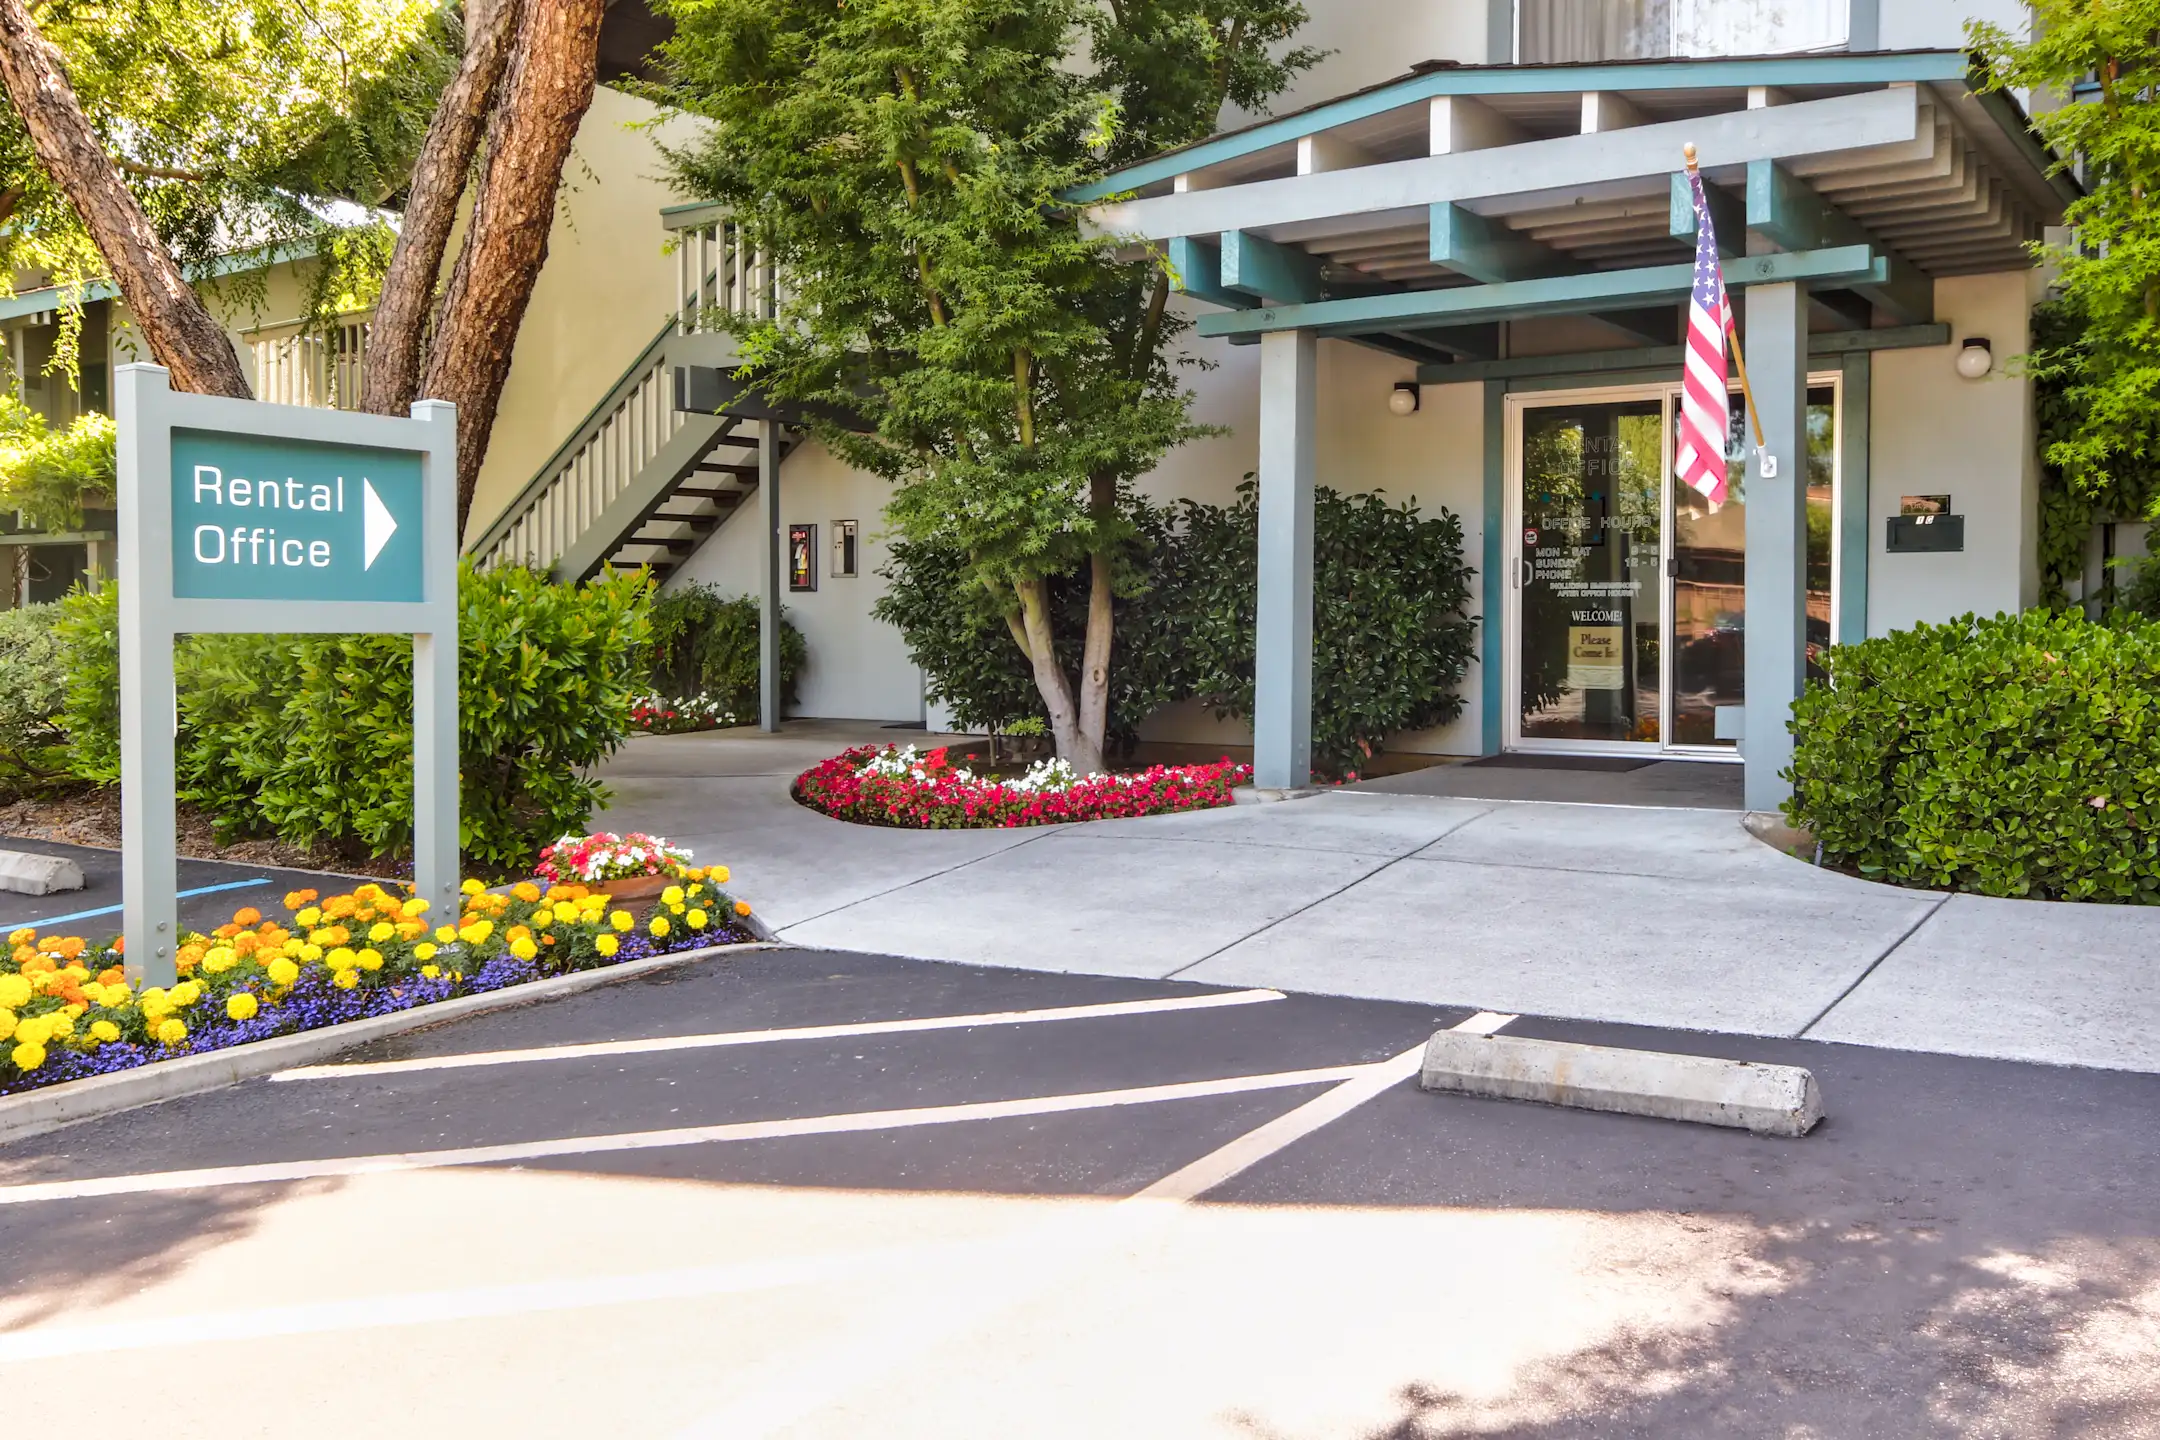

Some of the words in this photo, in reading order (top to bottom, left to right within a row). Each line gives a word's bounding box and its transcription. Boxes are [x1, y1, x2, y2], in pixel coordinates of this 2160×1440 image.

[1558, 458, 1635, 477] OFFICE
[193, 464, 344, 513] Rental
[1541, 516, 1591, 530] OFFICE
[1600, 515, 1652, 529] HOURS
[193, 524, 332, 568] Office
[1535, 547, 1560, 557] MON
[1571, 546, 1592, 557] SAT
[1535, 558, 1576, 568] SUNDAY
[1535, 569, 1572, 580] PHONE
[1580, 589, 1606, 598] OFFICE
[1571, 610, 1623, 622] WELCOME!
[1581, 633, 1612, 645] Please
[1573, 645, 1603, 658] Come
